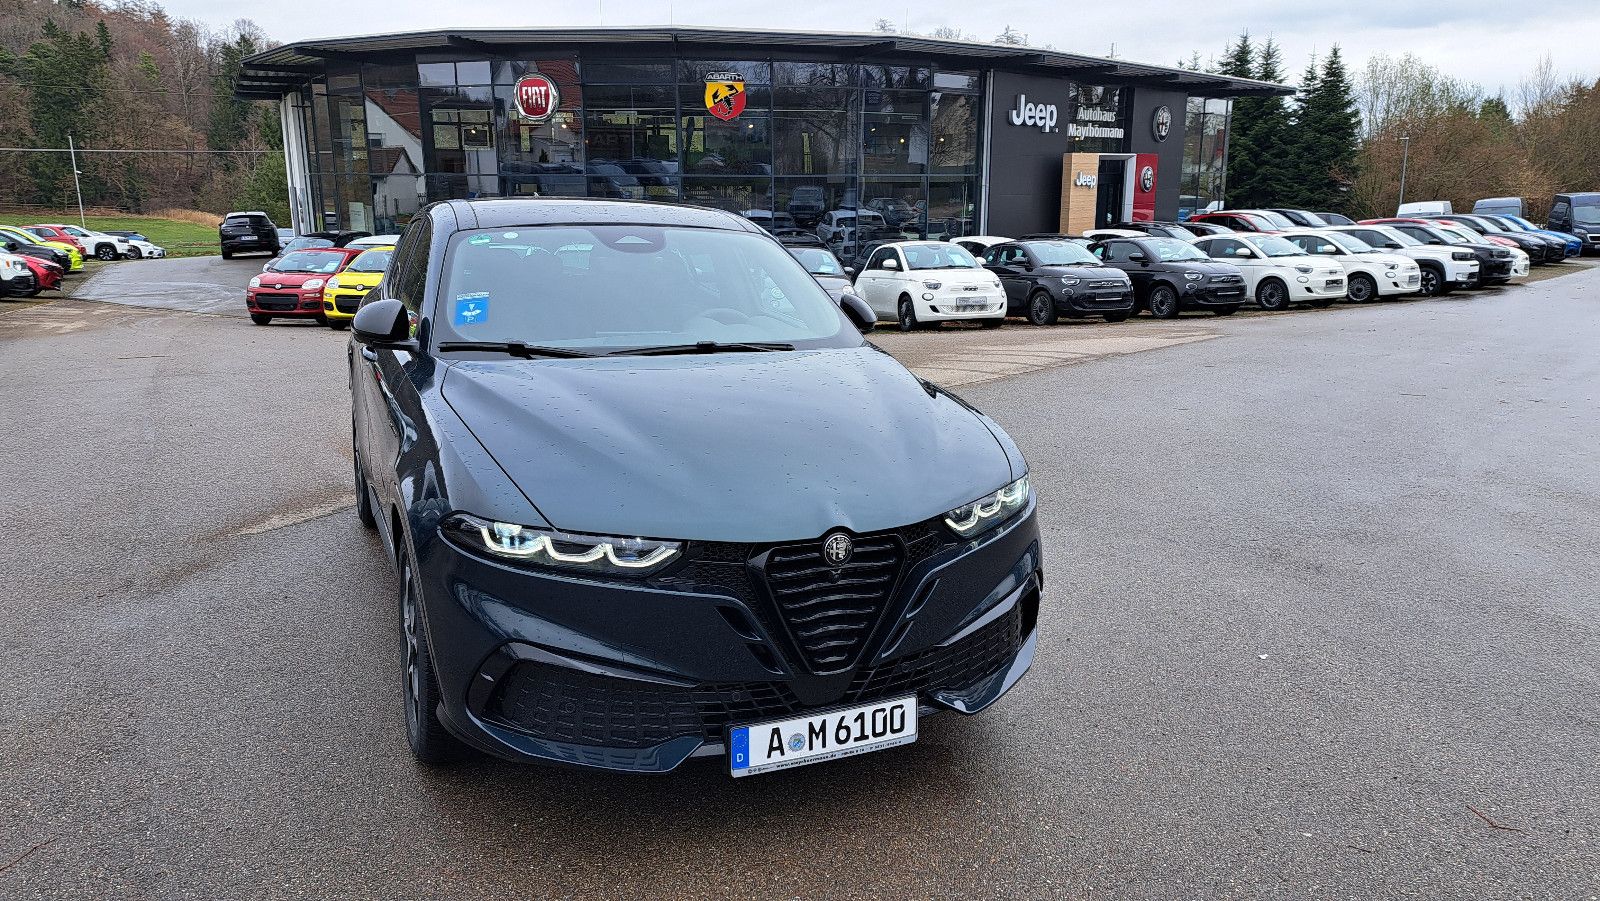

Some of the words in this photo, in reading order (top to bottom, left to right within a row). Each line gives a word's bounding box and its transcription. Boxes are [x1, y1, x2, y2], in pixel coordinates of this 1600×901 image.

[522, 86, 547, 108] FIAT
[1011, 94, 1058, 133] Jeep
[1076, 107, 1116, 122] Autohaus
[1067, 123, 1124, 140] Mayrhörmann
[1075, 172, 1097, 188] Jeep
[767, 727, 785, 759] A
[808, 719, 827, 750] M
[834, 704, 905, 745] 6100
[736, 753, 744, 763] D
